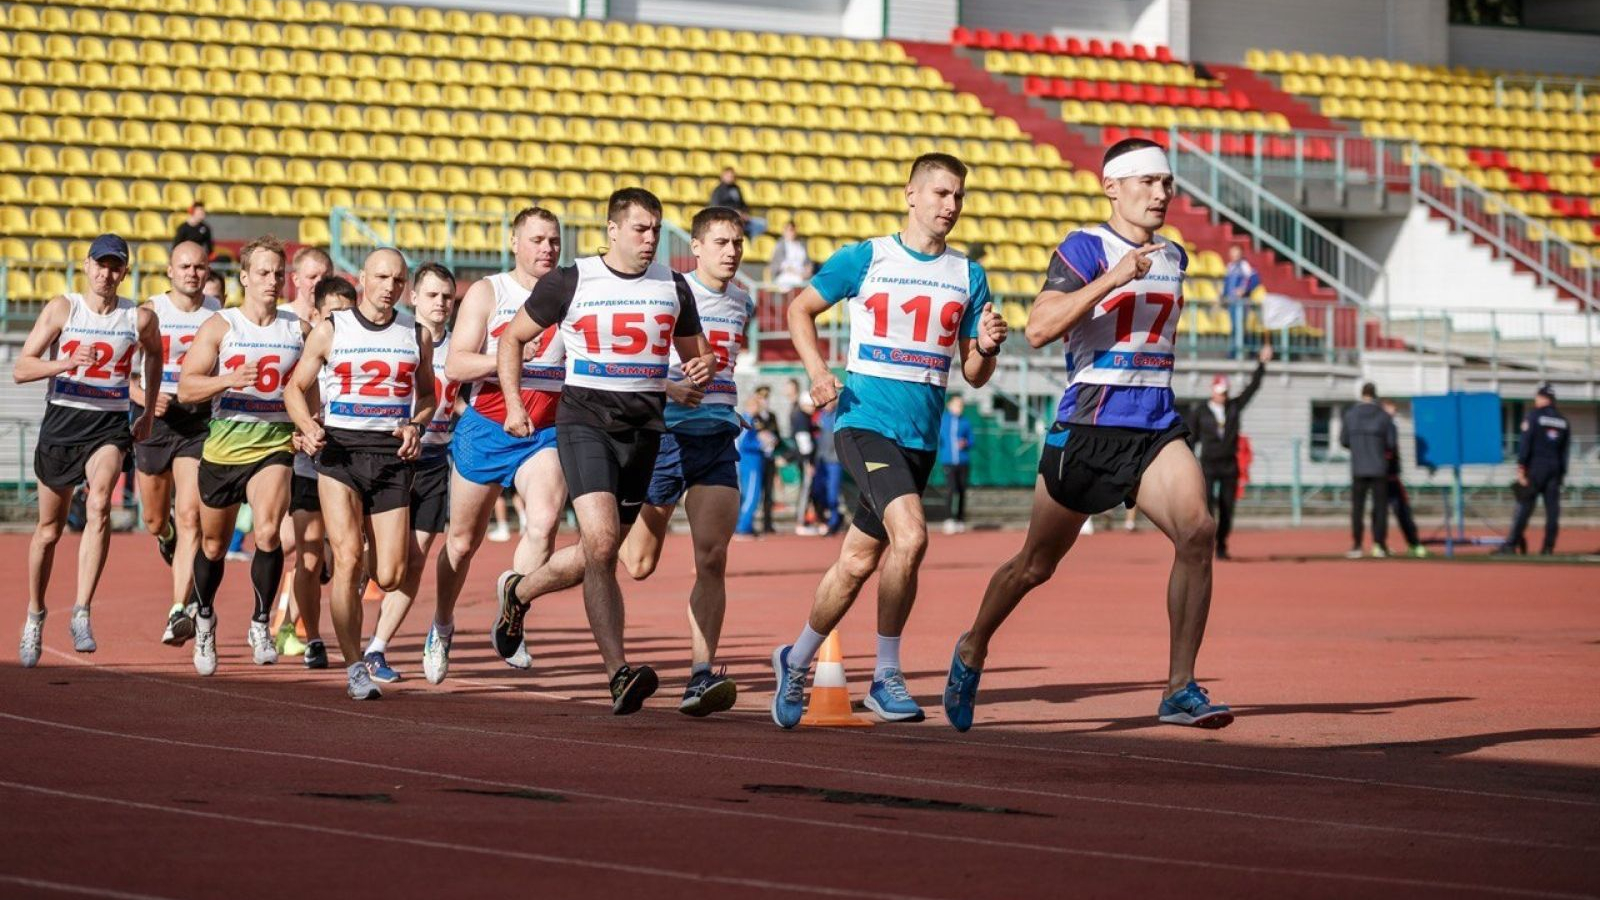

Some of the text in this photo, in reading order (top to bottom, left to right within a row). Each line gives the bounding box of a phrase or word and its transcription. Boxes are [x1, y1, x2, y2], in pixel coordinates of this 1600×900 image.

[877, 276, 939, 288] ГВАРДЕЙСКАЯ
[583, 300, 647, 308] ГВАРДЕЙСКАЯ
[648, 300, 676, 308] АРМИЯ
[864, 292, 964, 347] 119
[1101, 291, 1185, 345] 17
[340, 347, 392, 355] ГВАРДЕЙСКАЯ
[571, 312, 676, 356] 153
[61, 340, 135, 380] 124
[333, 360, 418, 397] 125
